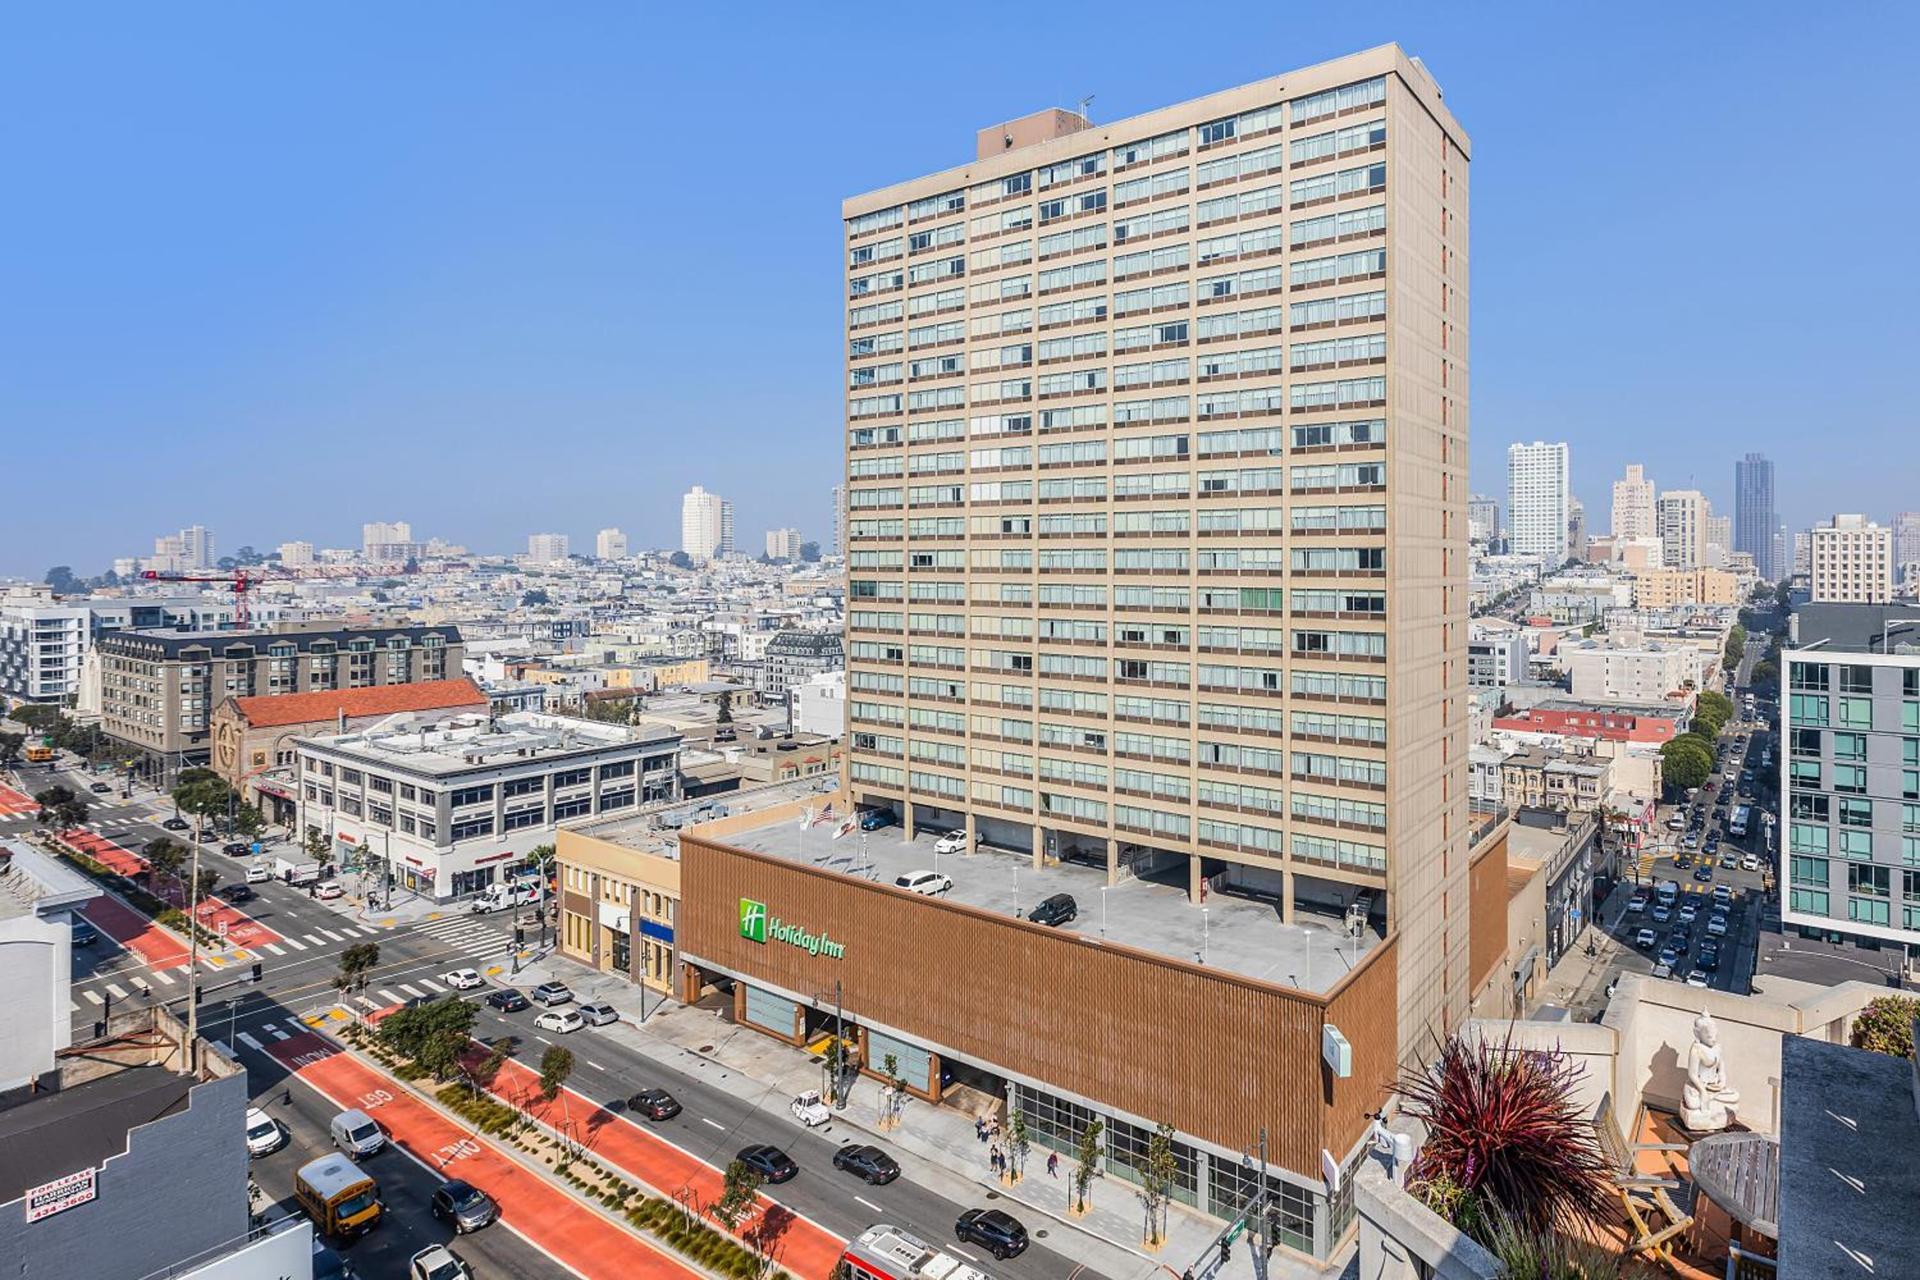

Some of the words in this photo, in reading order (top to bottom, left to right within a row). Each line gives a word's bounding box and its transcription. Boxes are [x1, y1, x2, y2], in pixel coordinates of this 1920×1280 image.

[768, 917, 820, 956] Holiday
[820, 933, 845, 960] Inn
[291, 1048, 333, 1066] MUNI
[432, 1138, 481, 1169] ONLY
[31, 1185, 53, 1196] FOR
[57, 1171, 91, 1187] LEASE
[34, 1192, 93, 1218] 434-3600
